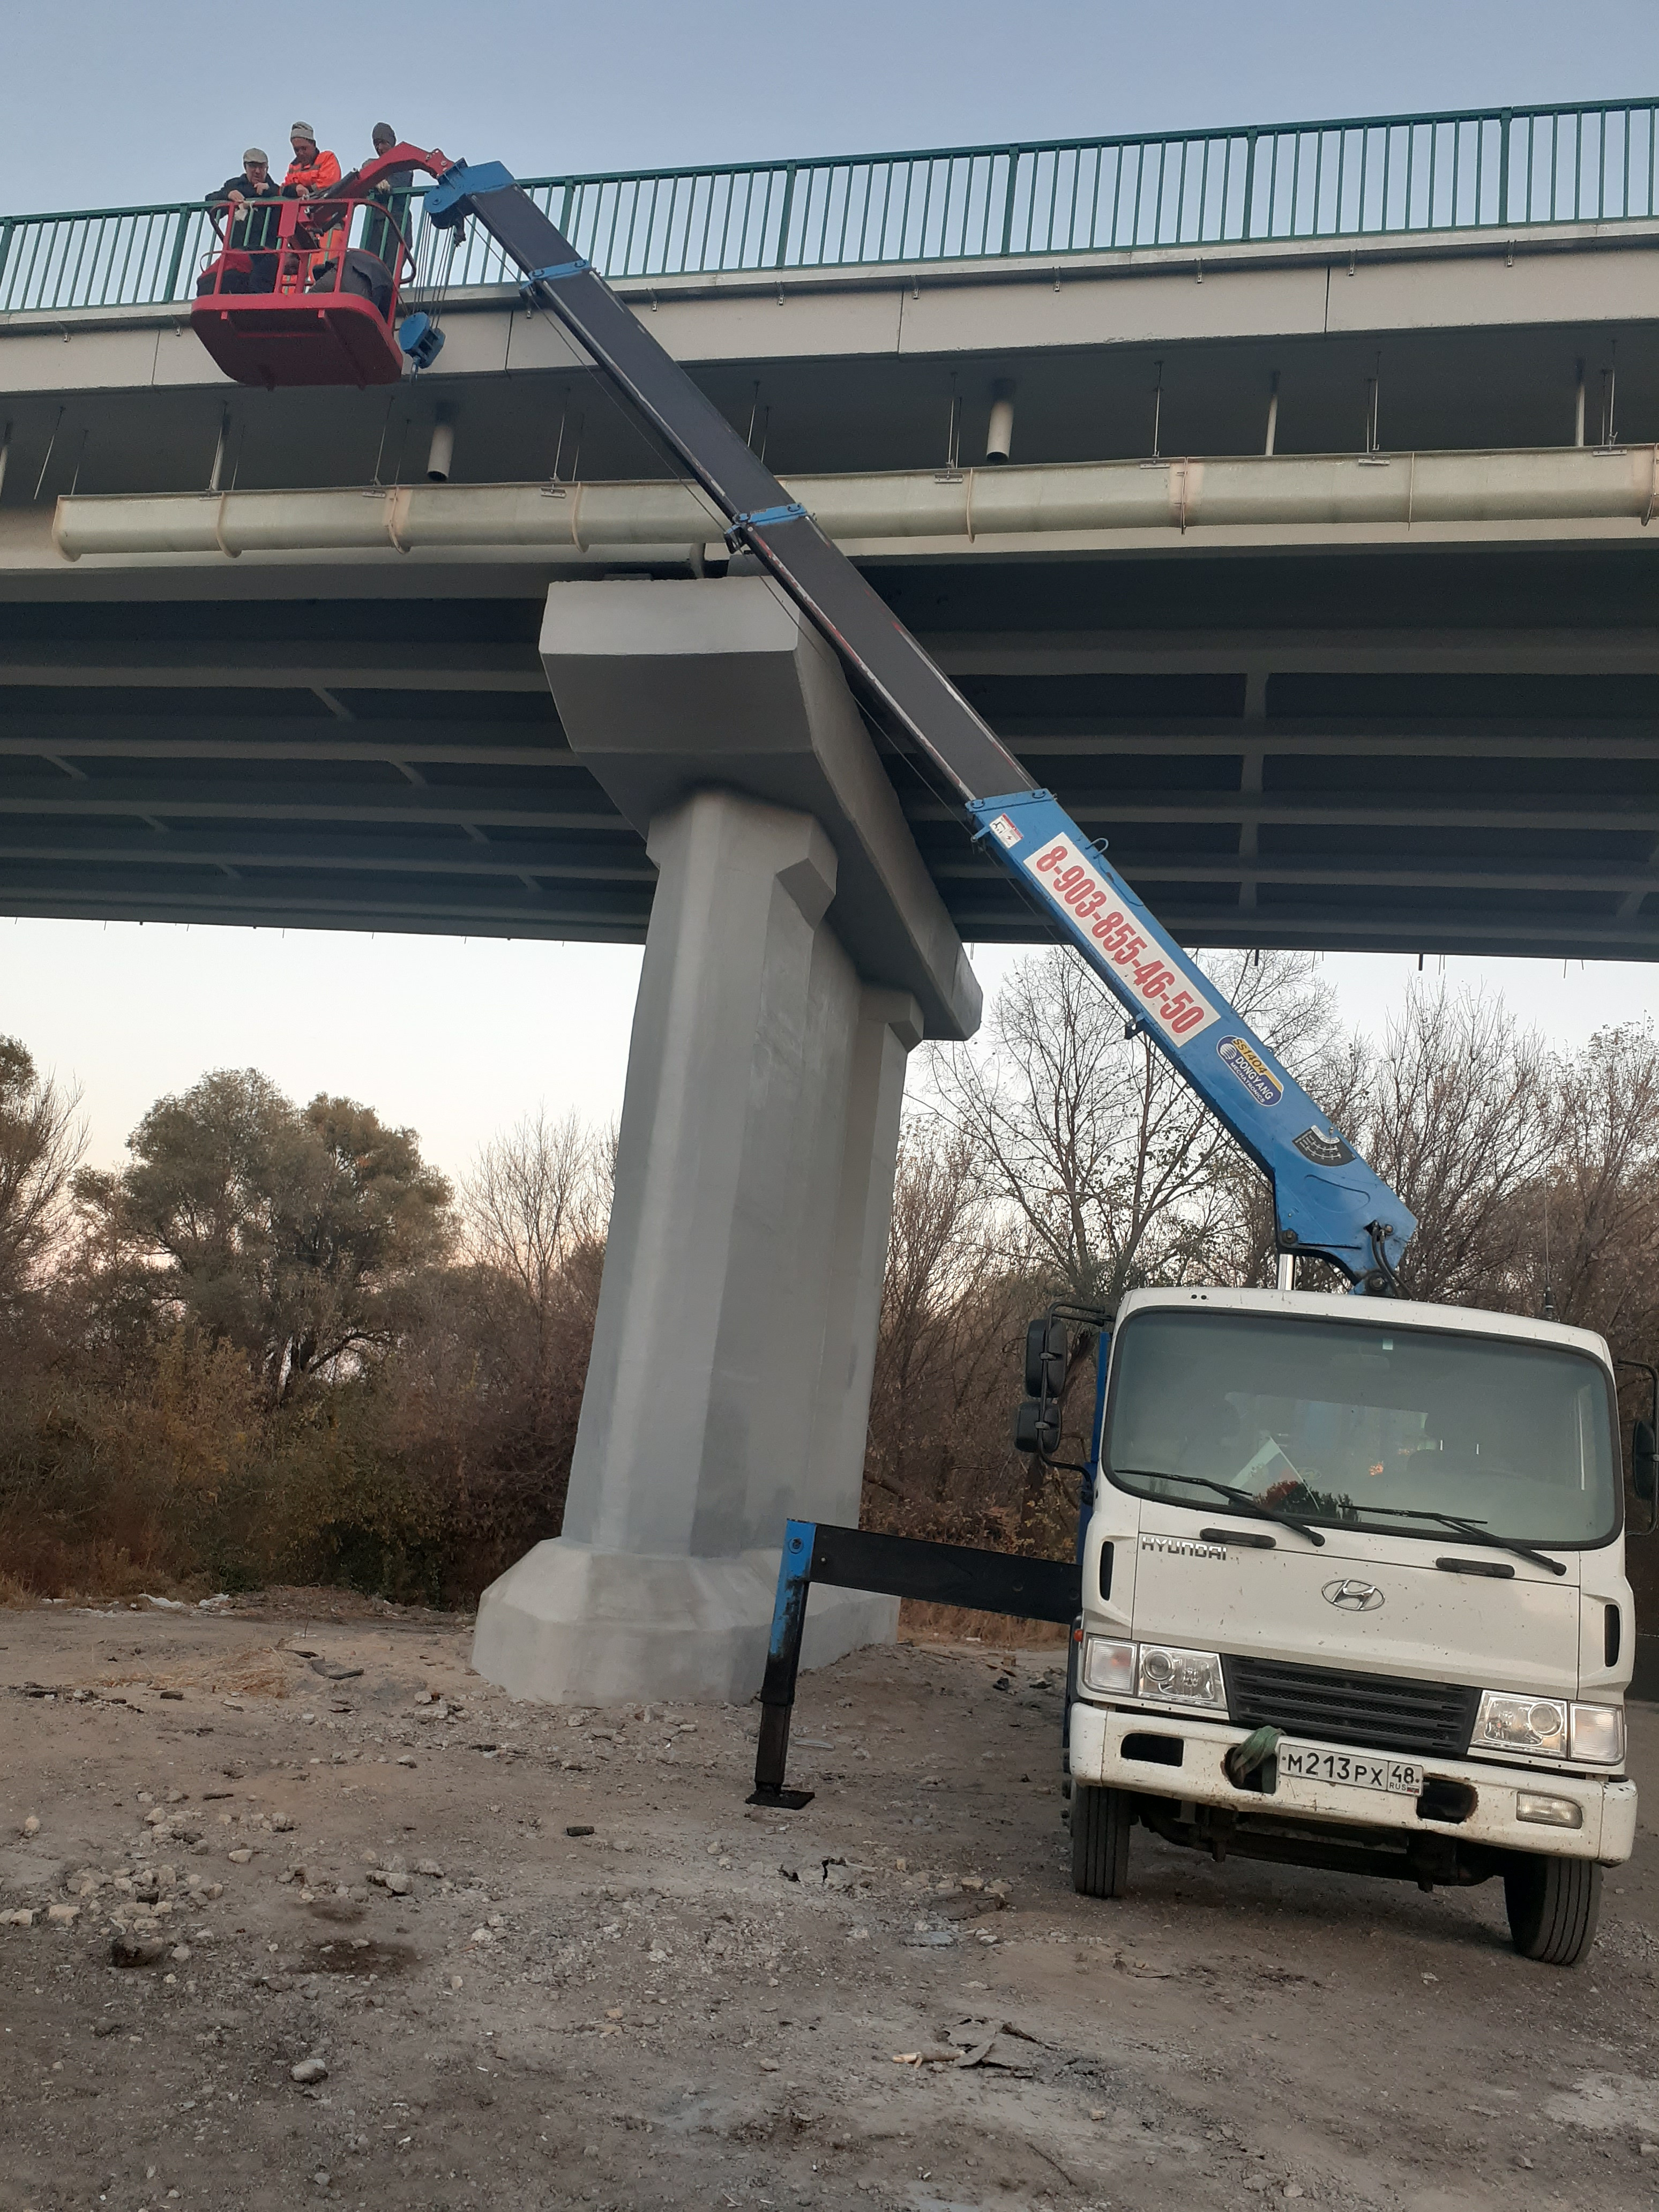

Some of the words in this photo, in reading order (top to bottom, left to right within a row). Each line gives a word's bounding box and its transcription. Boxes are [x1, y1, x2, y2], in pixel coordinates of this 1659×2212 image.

[1036, 845, 1205, 1034] 8-903-855-46-50
[1230, 1062, 1265, 1103] MECHATRONICS
[1235, 1056, 1274, 1100] DONGYANG
[1142, 1536, 1227, 1561] HYUNDAI
[1389, 1782, 1407, 1791] RUS
[1392, 1765, 1414, 1784] 48
